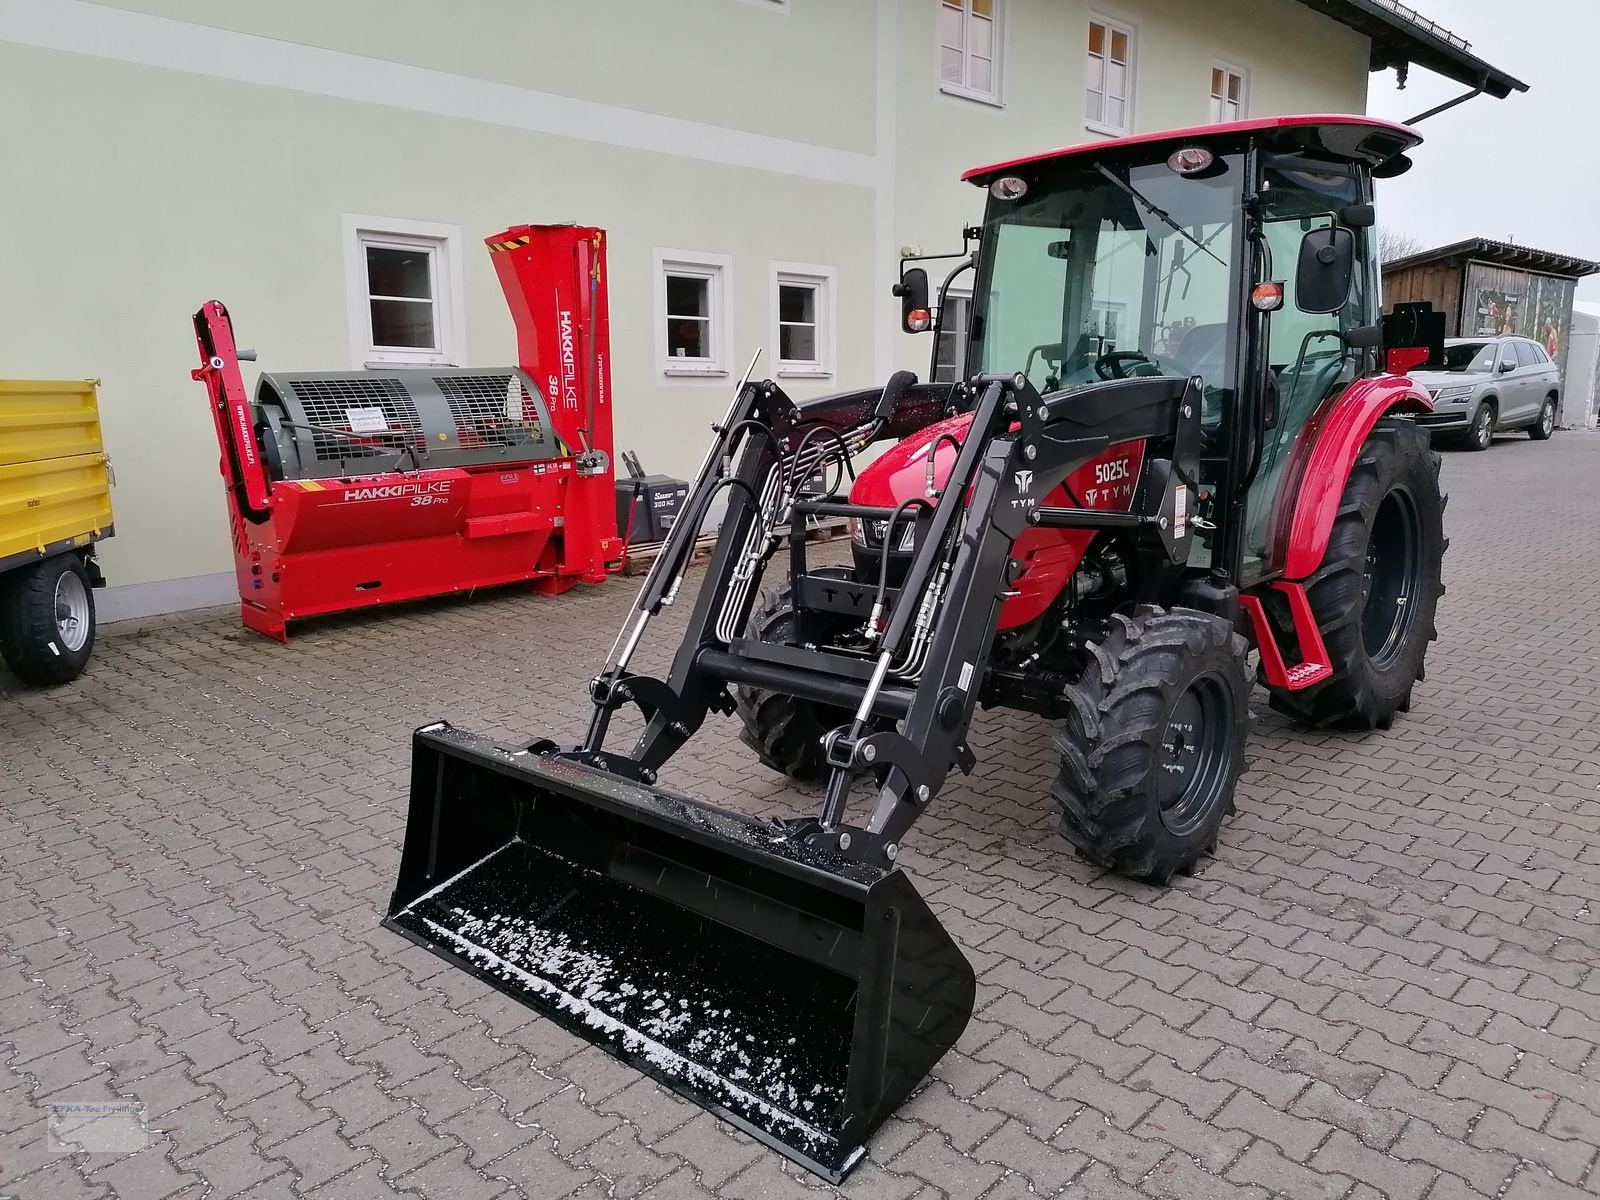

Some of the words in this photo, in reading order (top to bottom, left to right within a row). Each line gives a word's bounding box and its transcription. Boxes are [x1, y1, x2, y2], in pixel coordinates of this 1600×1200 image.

[560, 311, 577, 409] HAKKIPILKE
[549, 374, 559, 396] 38
[1095, 458, 1129, 484] 5025C
[344, 480, 451, 501] HAKKIPILKE
[1101, 483, 1131, 502] TYM
[410, 495, 433, 507] 38
[653, 500, 666, 508] 300
[1011, 498, 1035, 509] TYM
